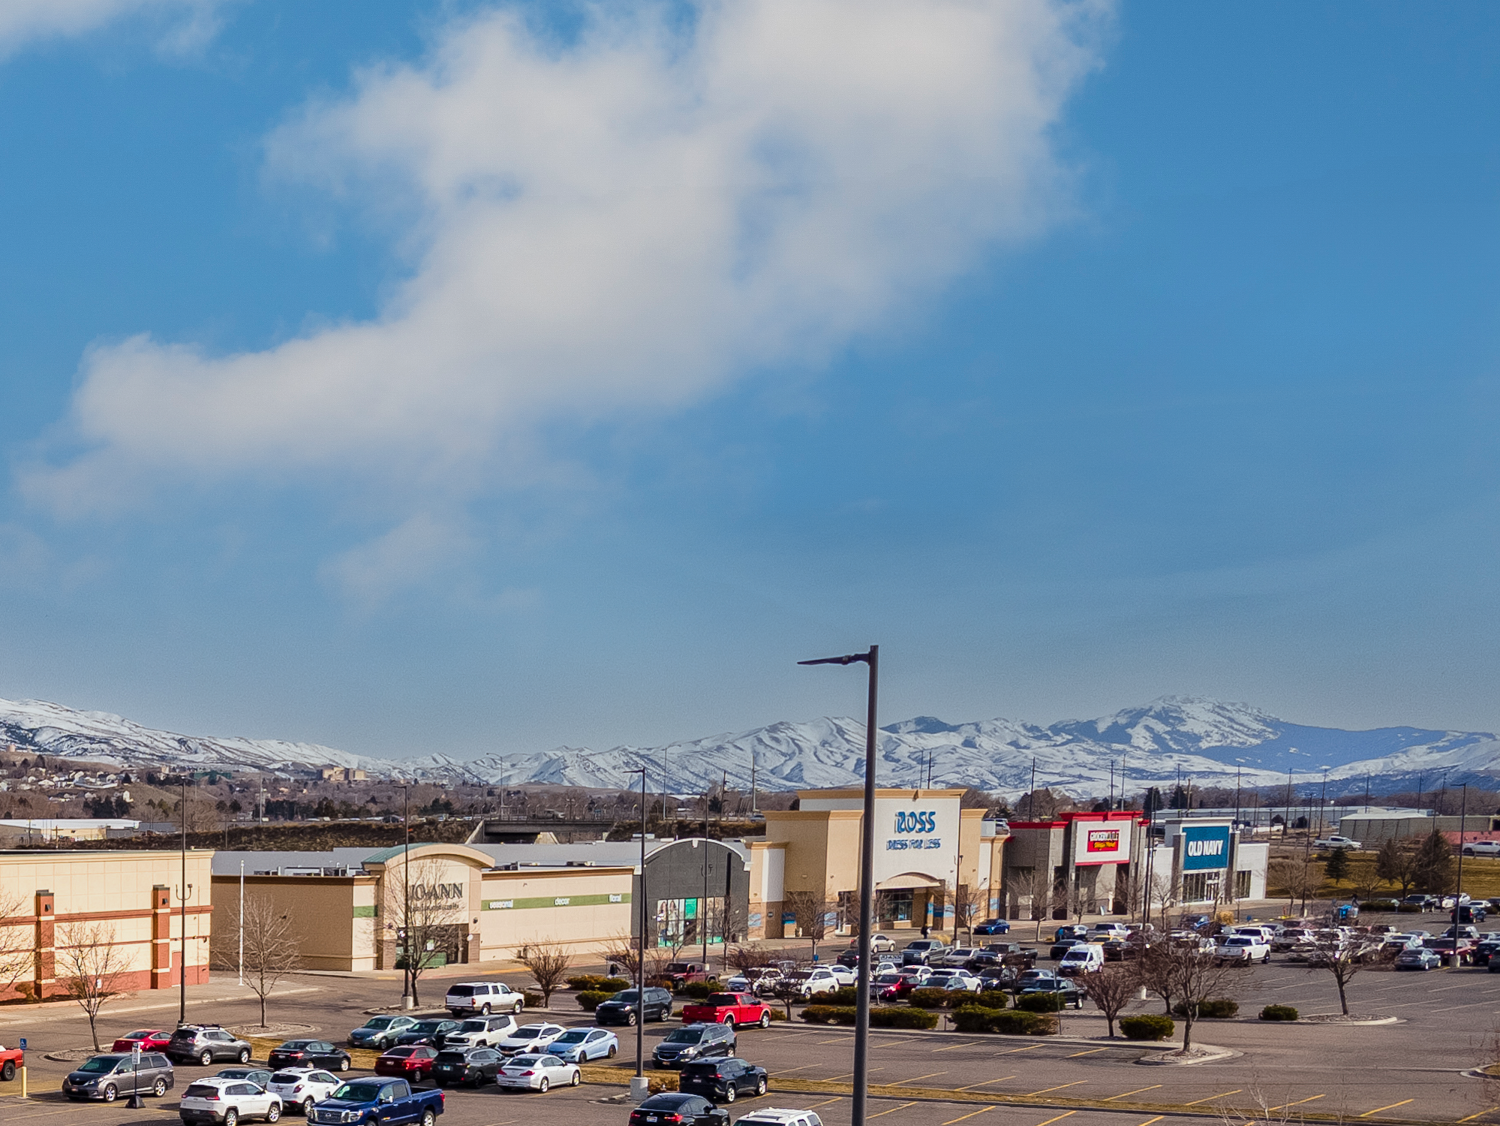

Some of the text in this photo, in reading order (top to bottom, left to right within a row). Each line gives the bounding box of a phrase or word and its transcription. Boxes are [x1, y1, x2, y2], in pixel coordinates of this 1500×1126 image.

[895, 811, 936, 833] ROSS
[1188, 840, 1223, 857] OLD NAVY
